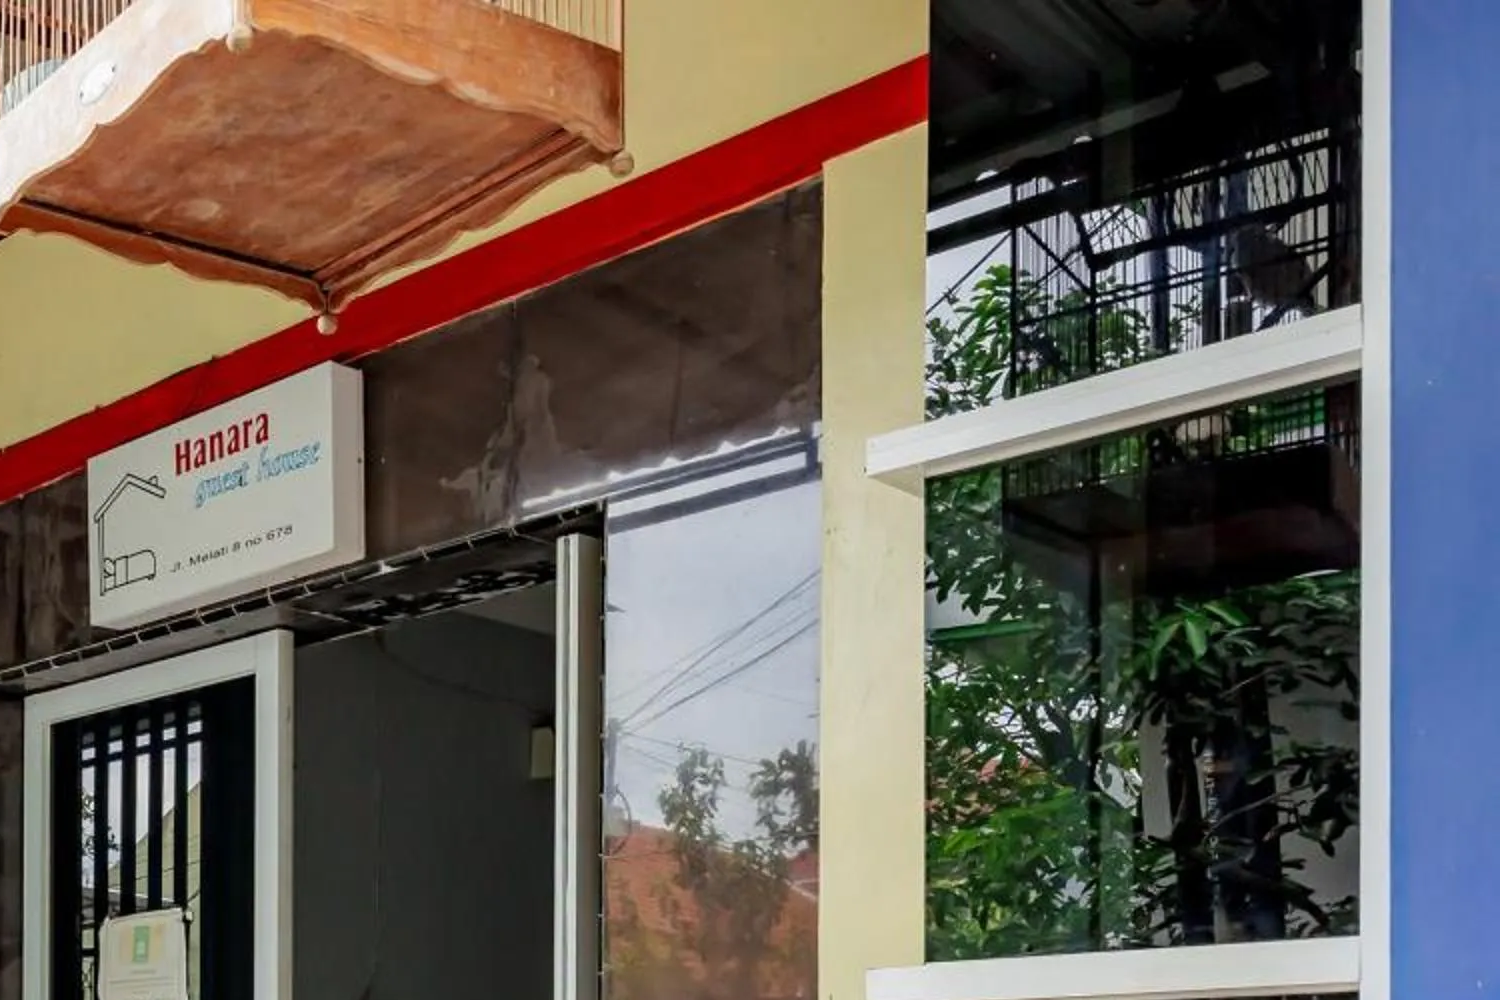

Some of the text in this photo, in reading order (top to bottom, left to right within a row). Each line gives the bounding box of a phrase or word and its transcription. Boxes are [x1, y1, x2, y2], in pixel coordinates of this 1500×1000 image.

[175, 413, 269, 476] Hanara
[196, 441, 321, 508] guest house
